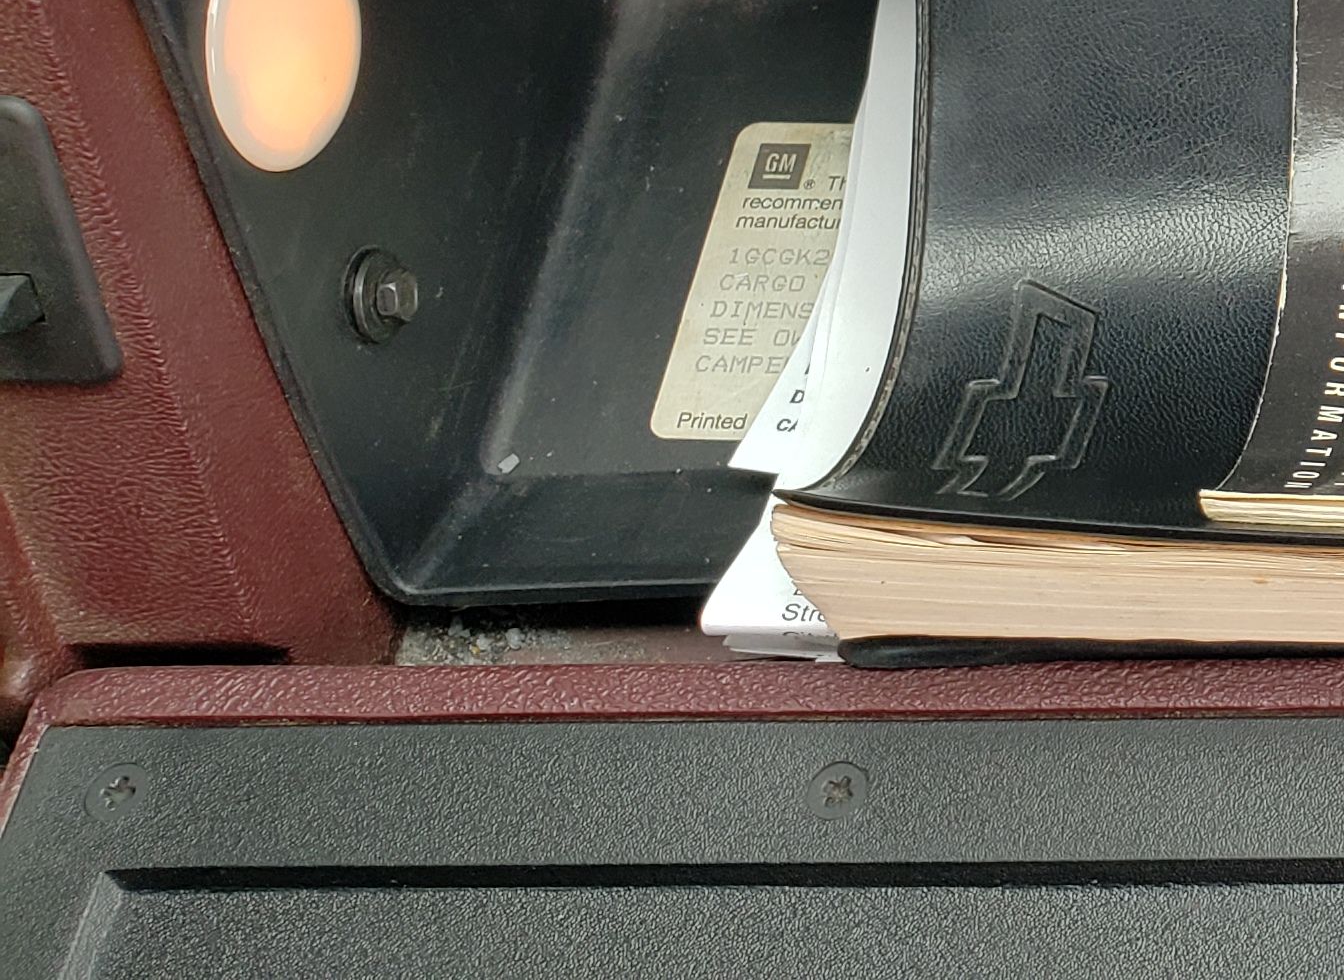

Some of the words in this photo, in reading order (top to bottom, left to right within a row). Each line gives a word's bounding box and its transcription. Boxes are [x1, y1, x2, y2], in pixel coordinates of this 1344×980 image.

[764, 153, 797, 173] GM
[729, 248, 831, 266] 1GCGK2
[720, 275, 805, 293] CARGO
[710, 300, 814, 320] DIMENS
[703, 328, 757, 346] SEE
[696, 355, 789, 374] CAMPE
[677, 412, 748, 430] Printed
